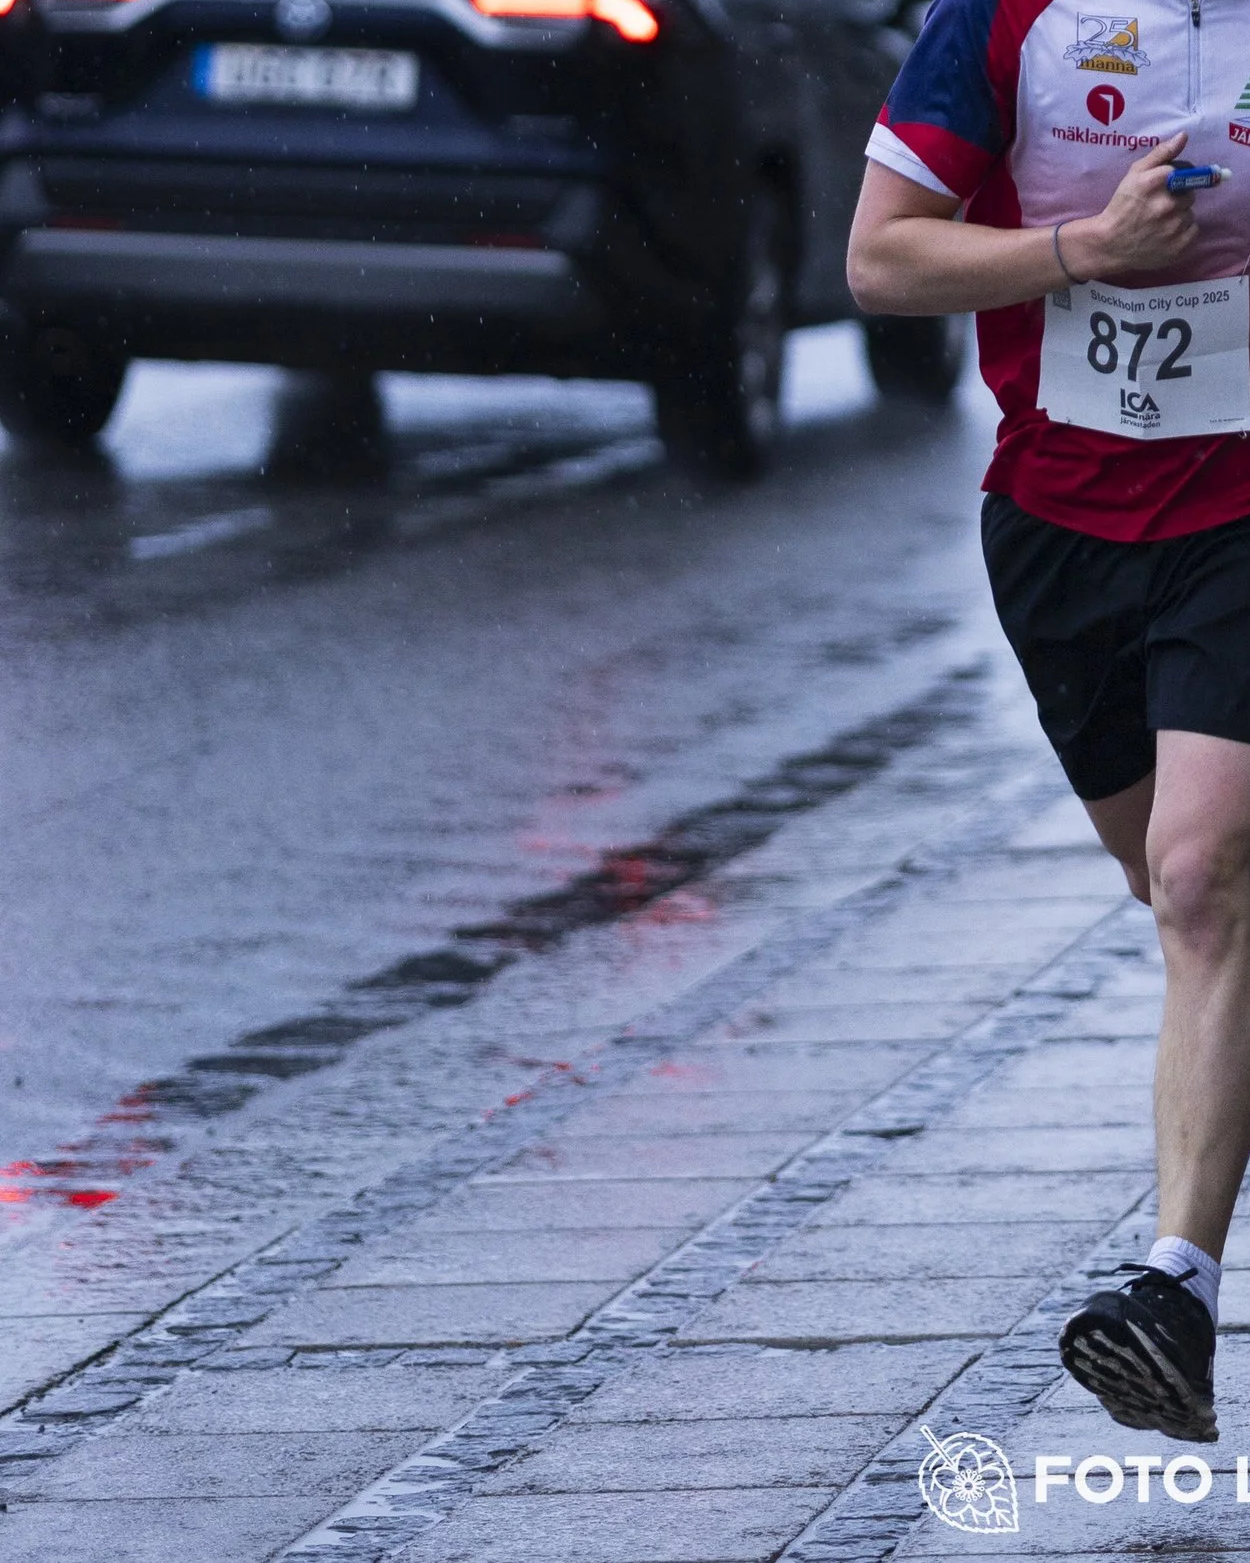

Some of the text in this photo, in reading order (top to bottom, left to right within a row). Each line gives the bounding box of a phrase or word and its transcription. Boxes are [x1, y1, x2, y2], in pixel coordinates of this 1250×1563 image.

[1080, 17, 1135, 47] 25
[1080, 56, 1135, 73] manna
[1052, 126, 1160, 151] mäklarringen
[1090, 289, 1230, 312] Stockholm City Cup 2025
[1087, 310, 1192, 382] 872
[1120, 388, 1160, 413] ICA
